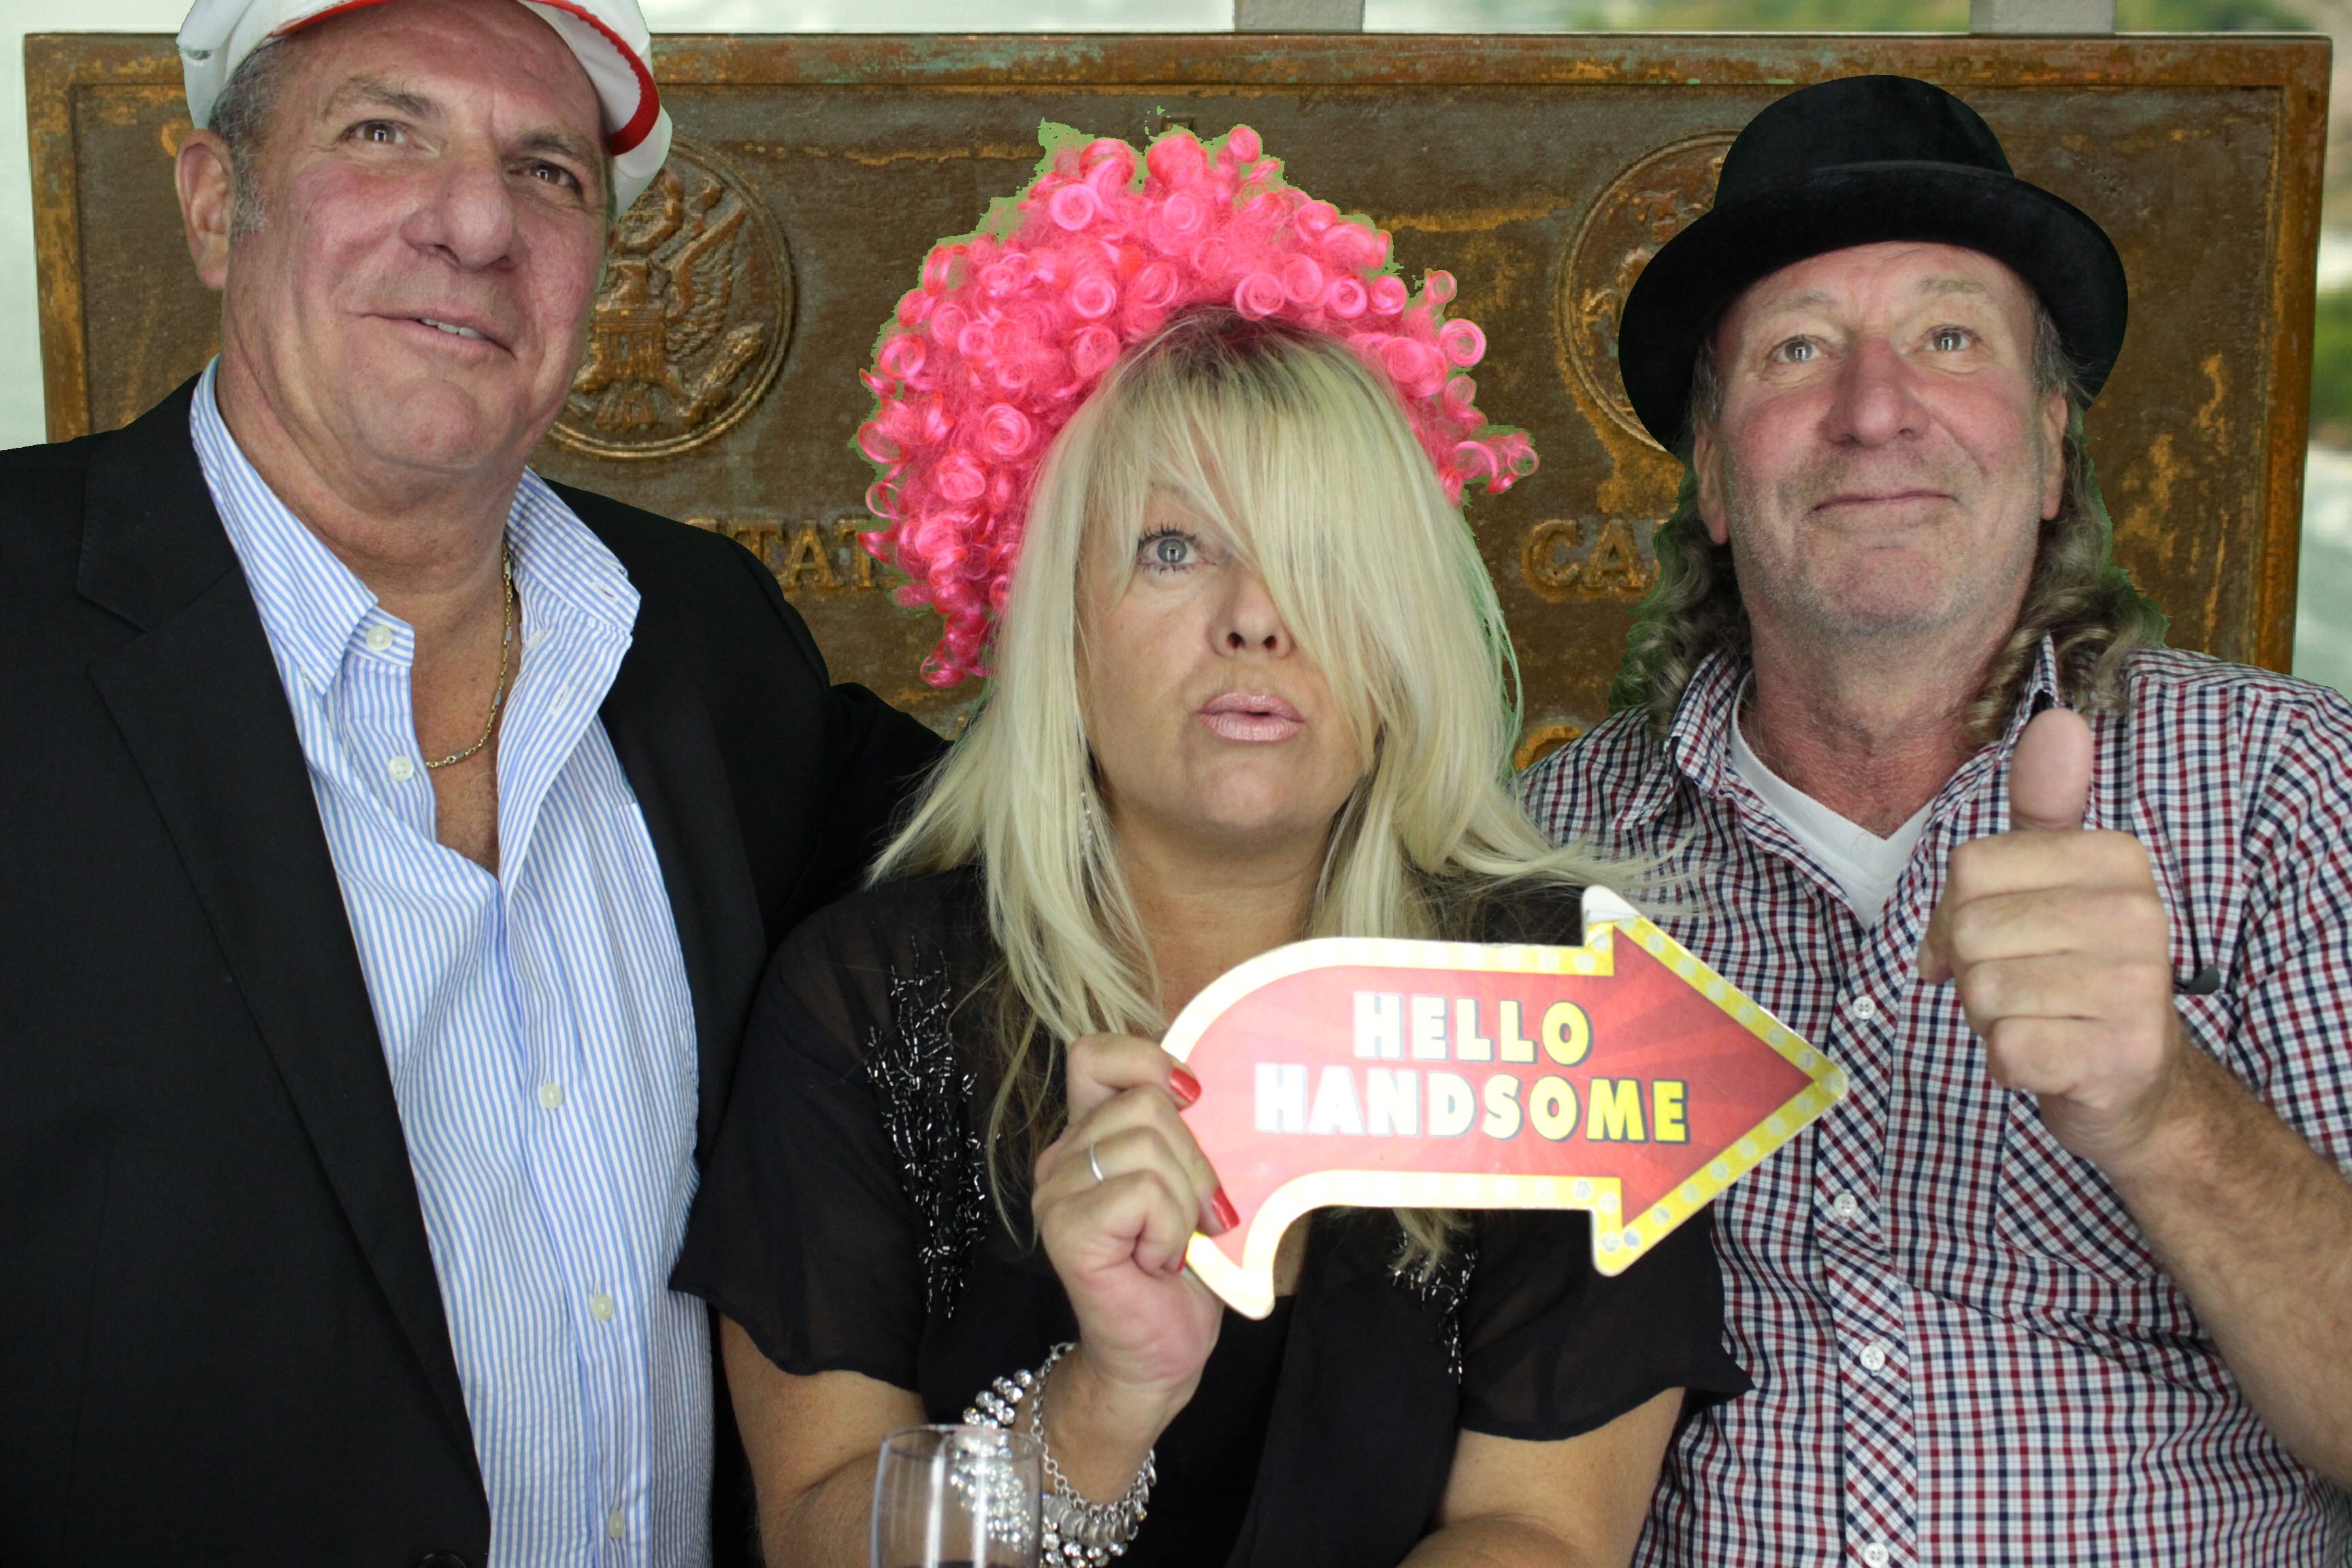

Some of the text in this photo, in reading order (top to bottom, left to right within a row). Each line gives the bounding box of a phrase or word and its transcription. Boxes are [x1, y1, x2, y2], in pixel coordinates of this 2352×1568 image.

[1520, 517, 1662, 595] CA
[1354, 992, 1593, 1066] HELLO
[1254, 1062, 1690, 1144] HANDSOME
